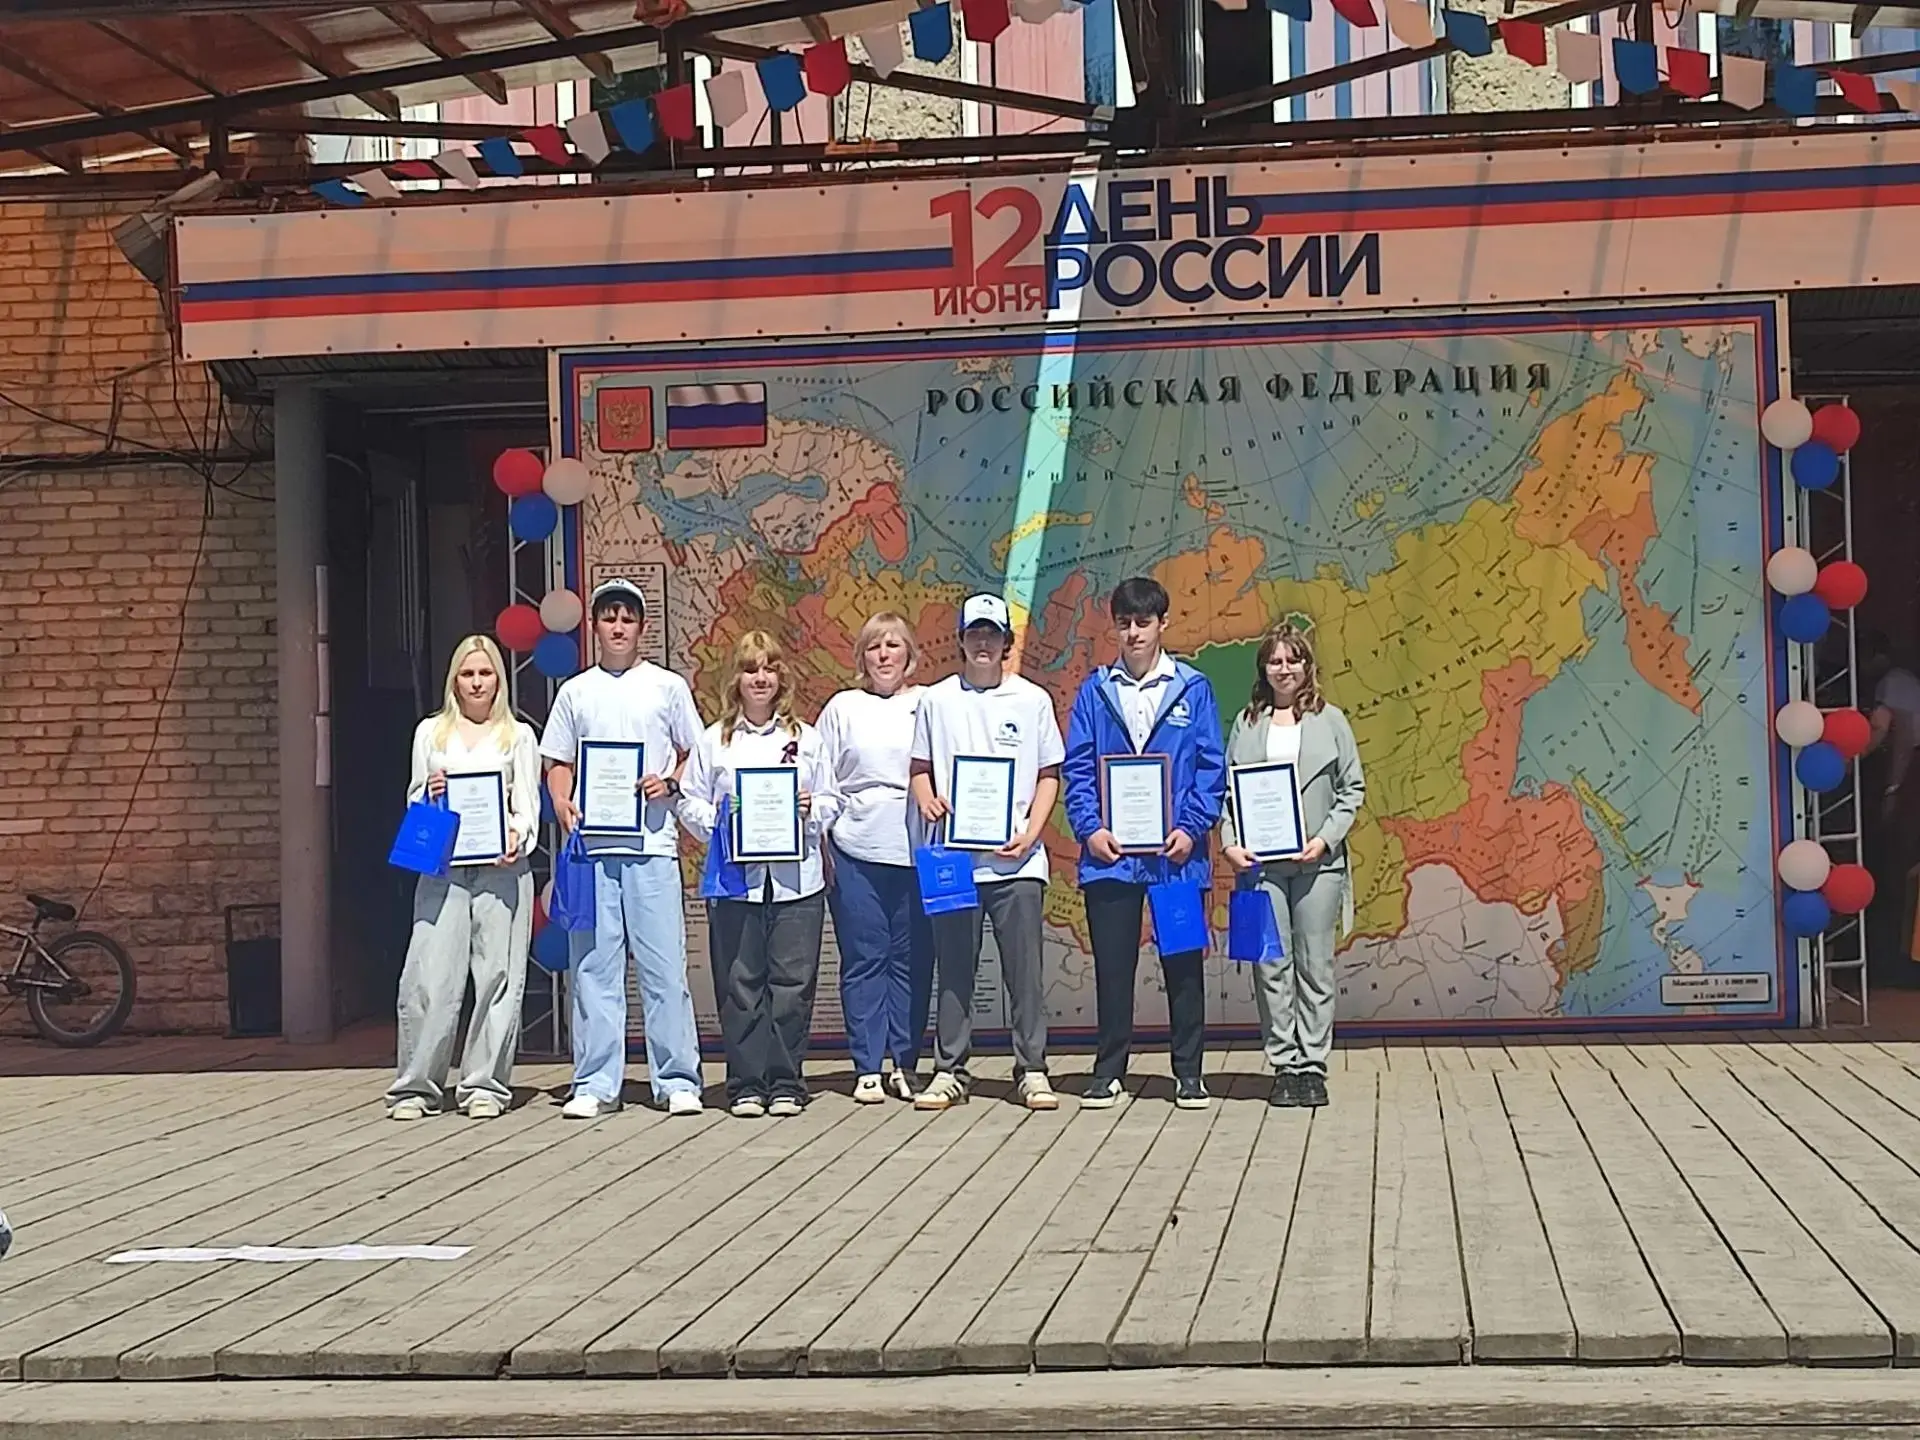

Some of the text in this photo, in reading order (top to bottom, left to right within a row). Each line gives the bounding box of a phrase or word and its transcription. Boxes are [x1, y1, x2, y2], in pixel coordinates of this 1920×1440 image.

[929, 175, 1264, 288] 12 ДЕНЬ
[934, 232, 1382, 316] ИЮНЯ РОССИИ
[925, 362, 1551, 415] РОССИЙСКАЯ ФЕДЕРАЦИЯ
[1397, 406, 1513, 421] ОКЕАН
